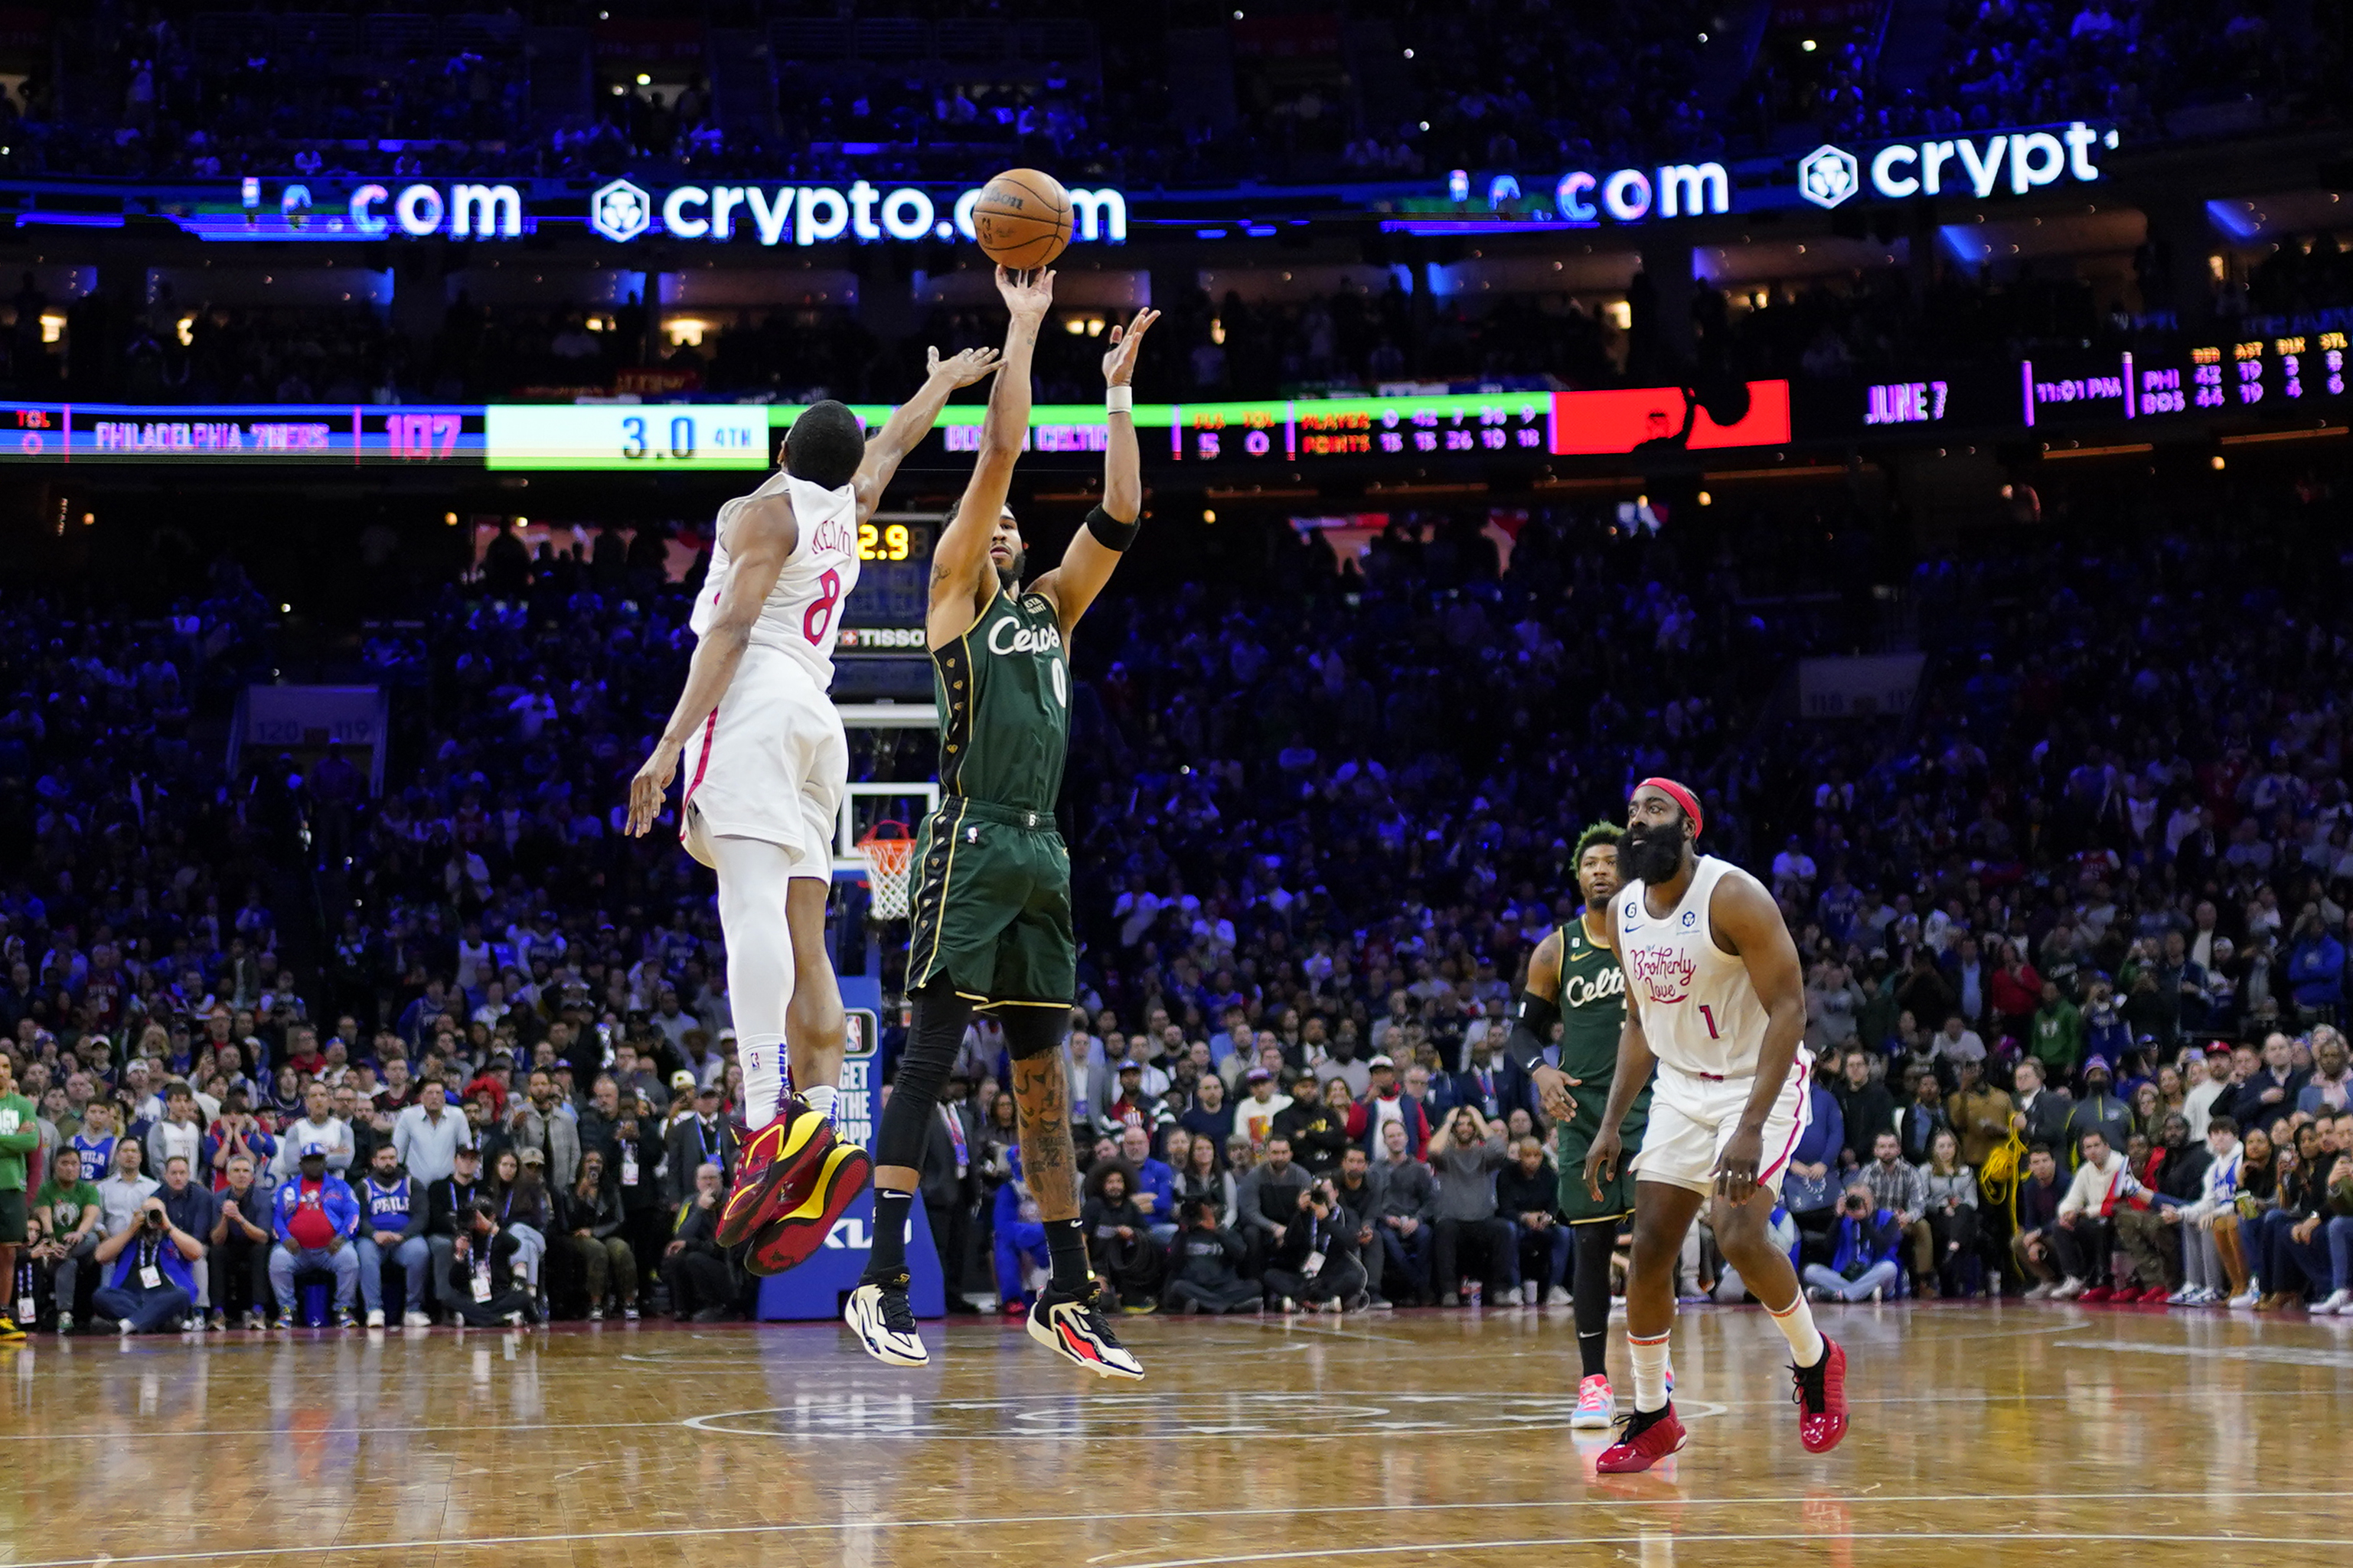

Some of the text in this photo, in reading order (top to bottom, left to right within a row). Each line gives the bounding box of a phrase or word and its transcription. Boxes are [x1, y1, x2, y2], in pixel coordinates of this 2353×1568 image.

[1871, 121, 2119, 197] crypt
[2233, 341, 2263, 360] AST
[2319, 332, 2348, 350] STL
[2086, 377, 2123, 399] PM
[2142, 368, 2180, 392] PHI
[1929, 381, 1948, 420] 7
[21, 431, 44, 456] 0
[95, 422, 243, 450] PHILADELPHIA
[385, 414, 462, 459] 107
[622, 417, 751, 460] 3.0 4TH
[1035, 425, 1108, 452] CELTIC
[1196, 432, 1221, 459] 5
[1244, 430, 1270, 456] 0
[857, 524, 909, 560] 2.9
[803, 568, 840, 646] 8
[858, 628, 925, 647] TISSO
[1051, 657, 1067, 709] 0
[1630, 947, 1697, 986] Brotherly
[1644, 976, 1689, 1005] Love
[1698, 1004, 1720, 1040] 1
[840, 1061, 870, 1090] GET
[840, 1091, 871, 1120] THE
[80, 1149, 106, 1165] HILA
